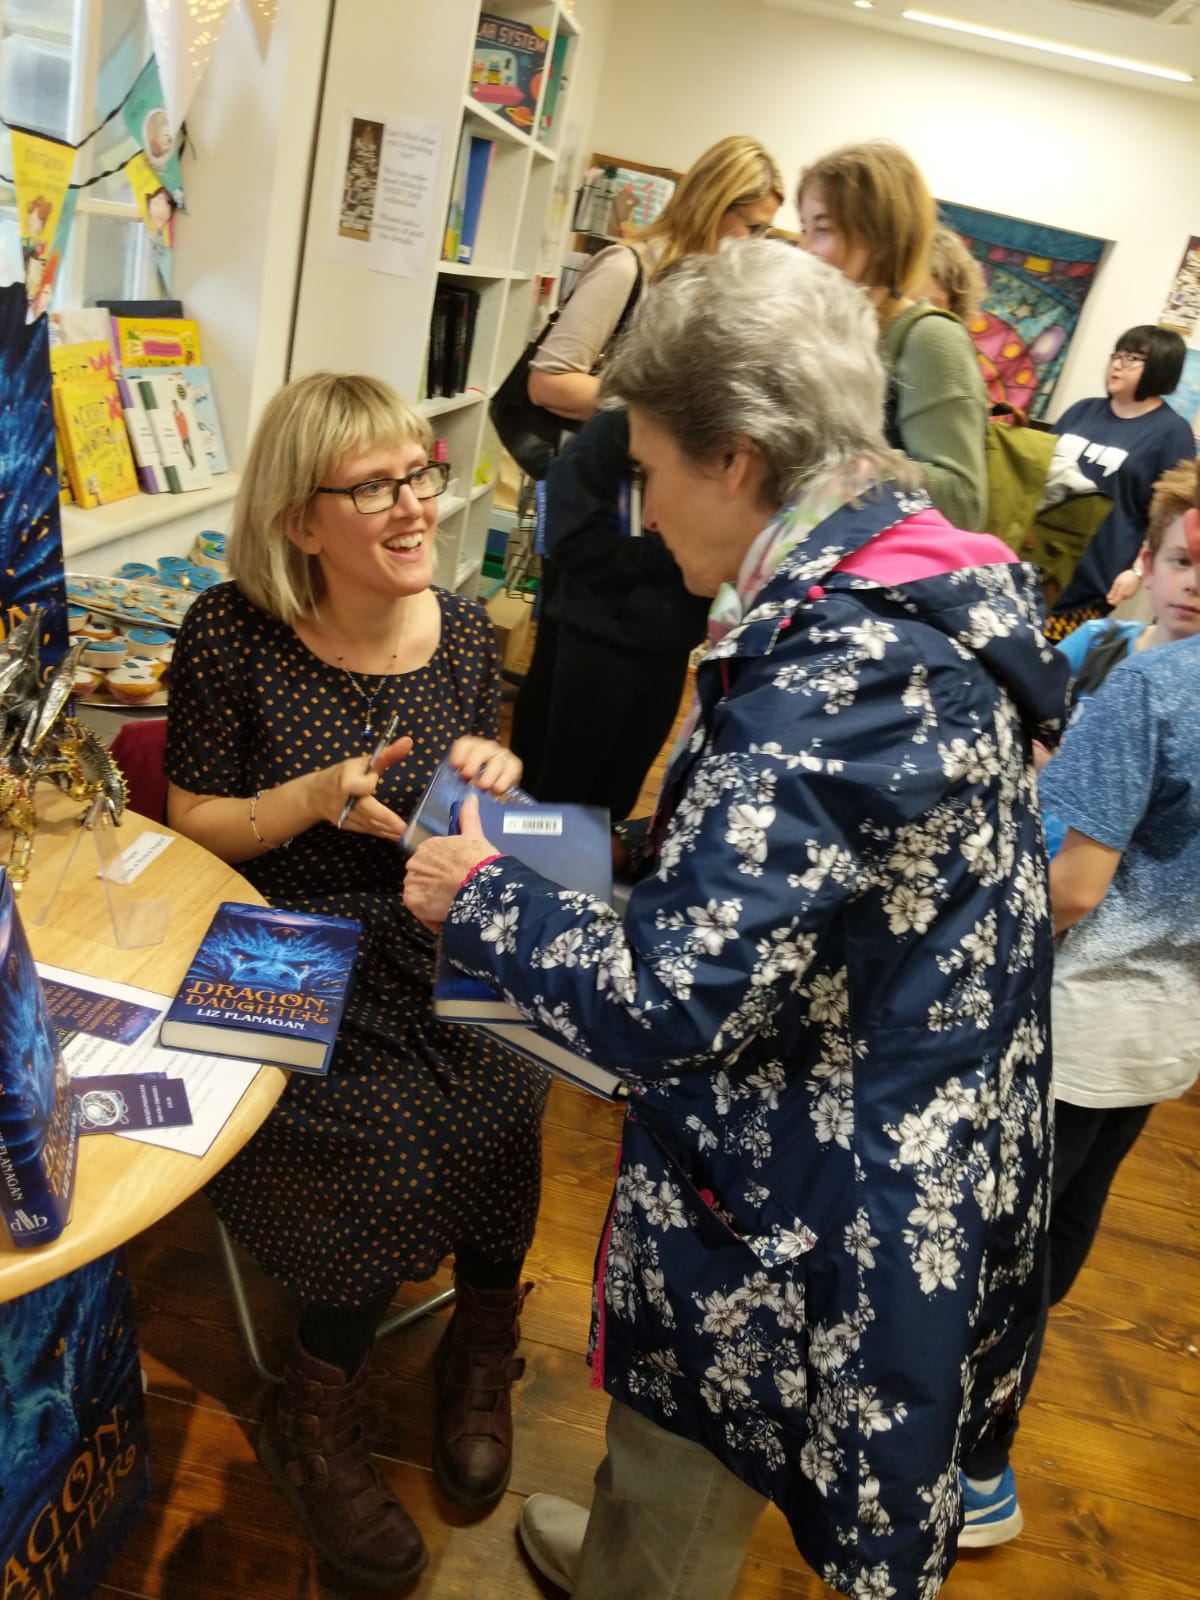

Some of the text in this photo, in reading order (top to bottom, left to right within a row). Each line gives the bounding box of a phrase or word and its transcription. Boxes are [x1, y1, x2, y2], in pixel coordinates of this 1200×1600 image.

[498, 26, 546, 53] SYSTEM
[185, 979, 326, 1012] DRAGON
[185, 994, 330, 1025] DAUGHTER
[196, 1008, 306, 1031] LIZ FLANAGAN
